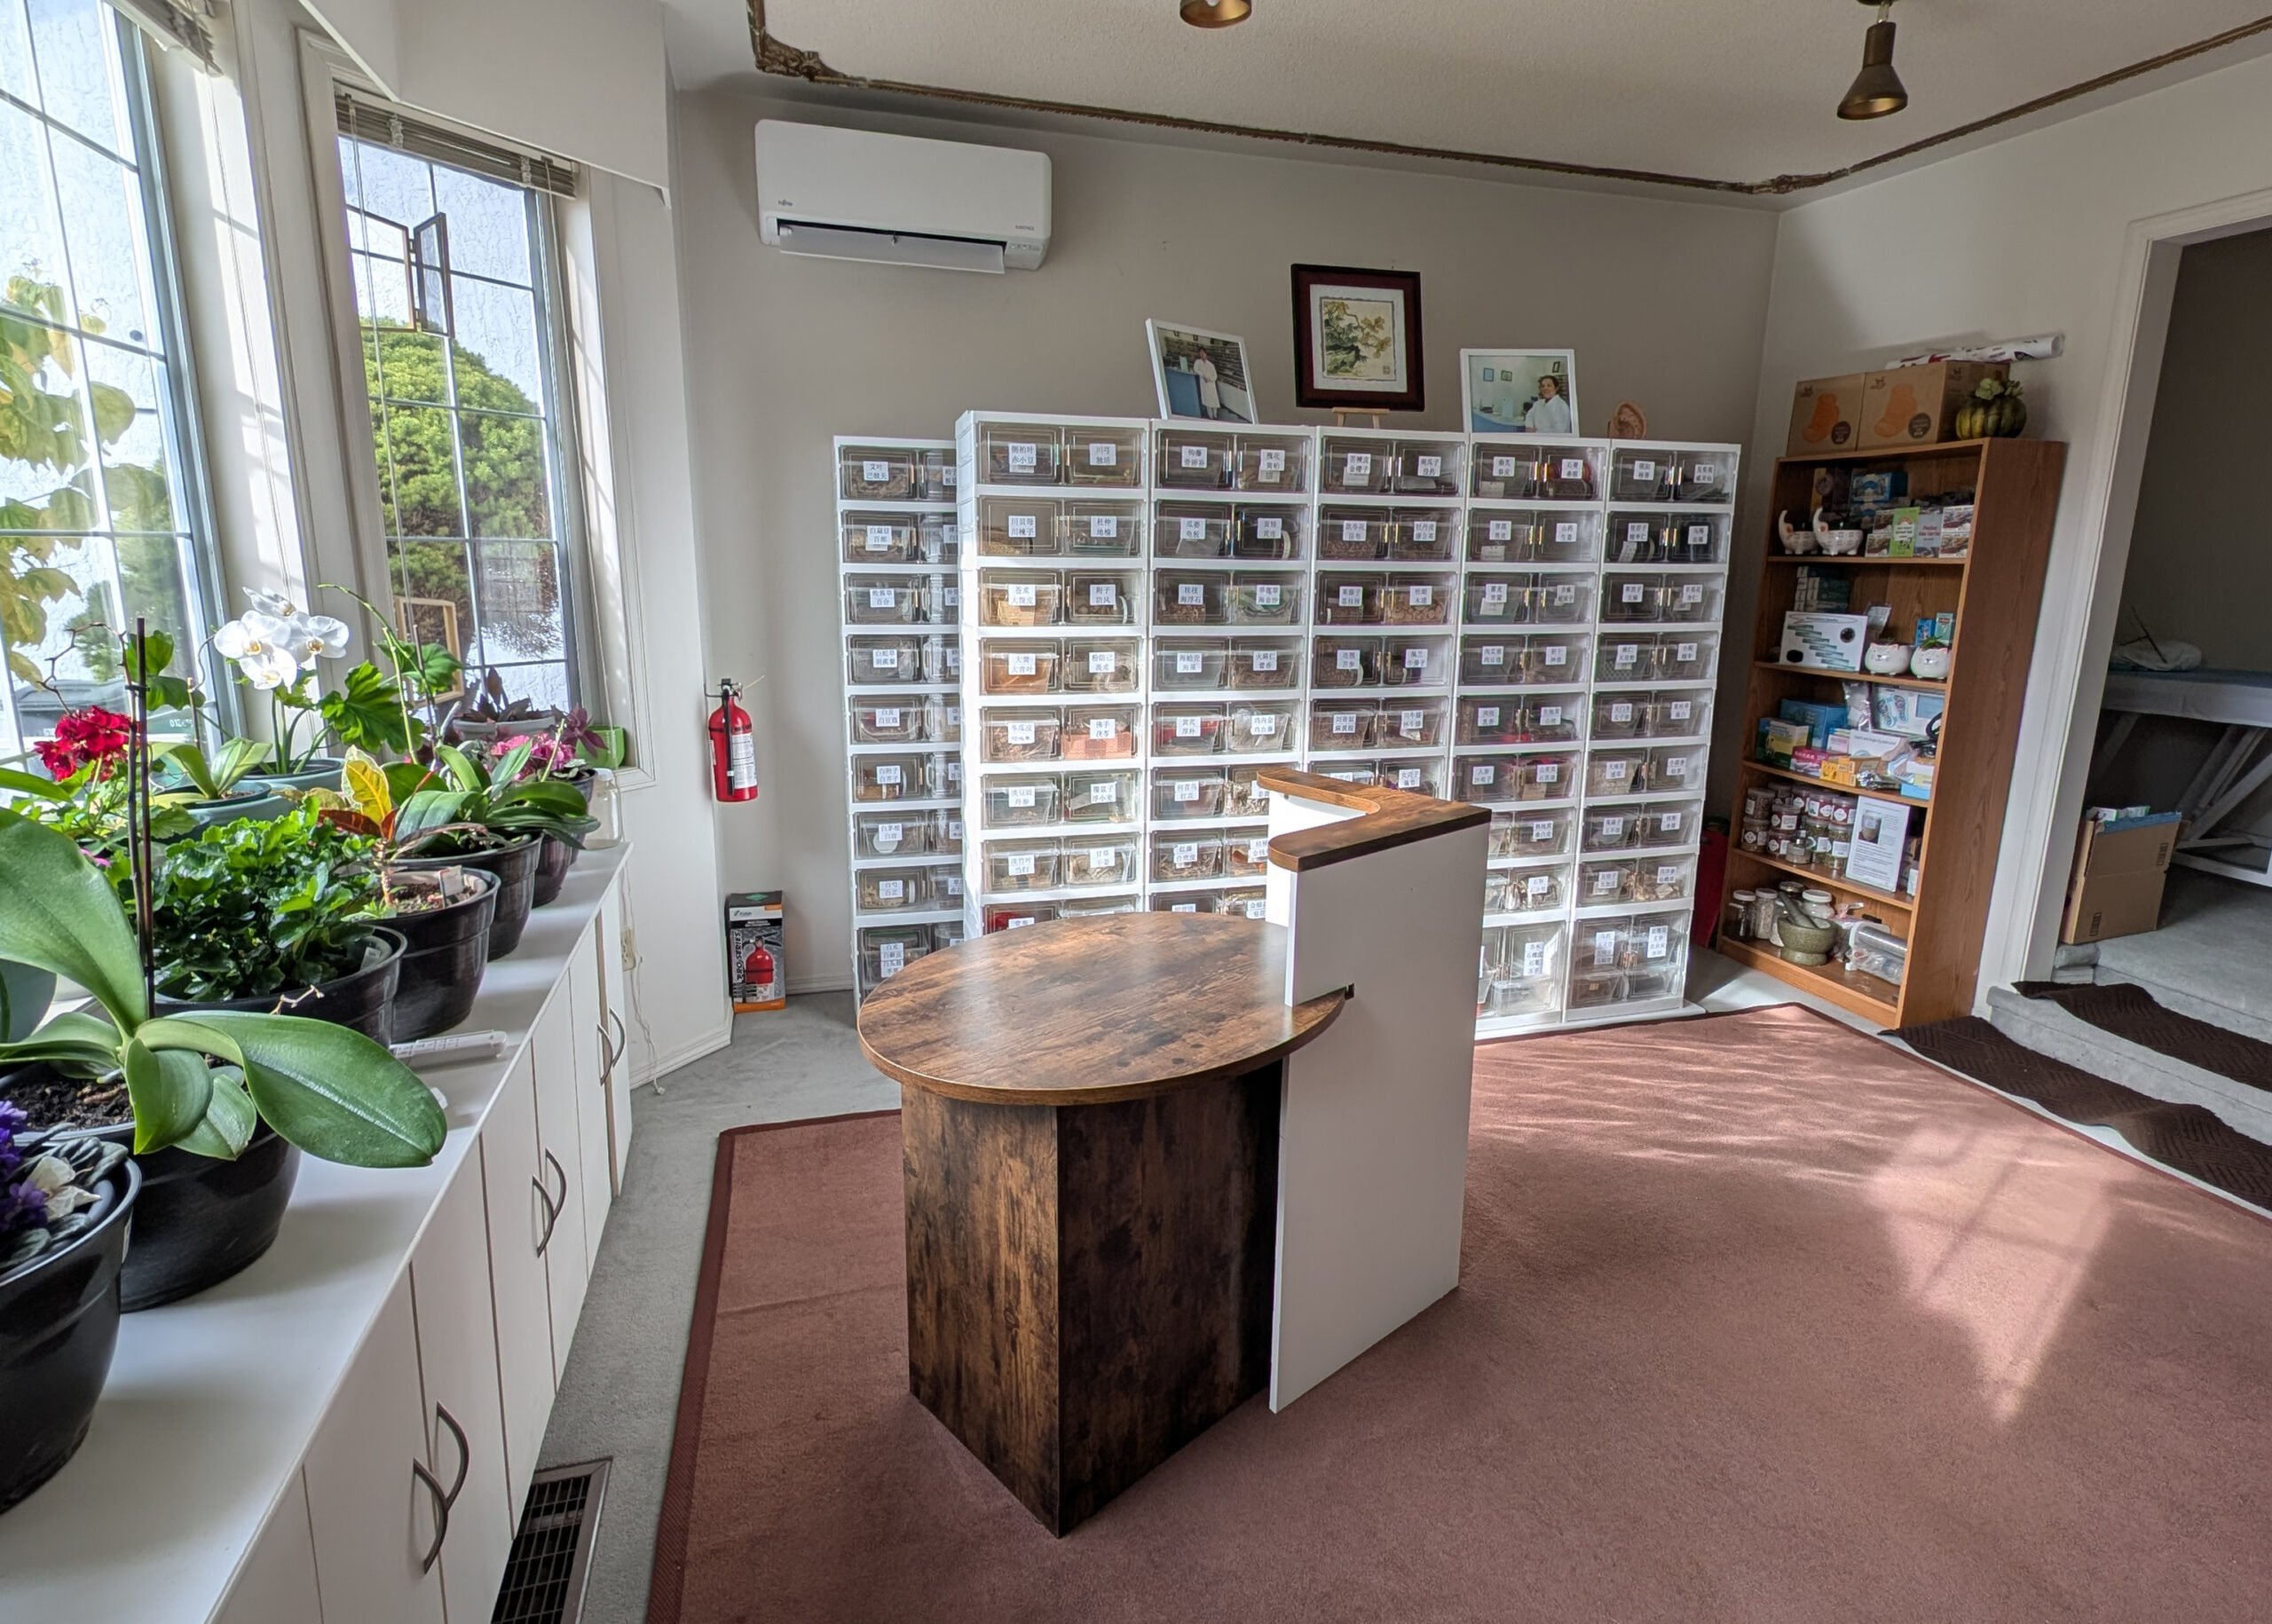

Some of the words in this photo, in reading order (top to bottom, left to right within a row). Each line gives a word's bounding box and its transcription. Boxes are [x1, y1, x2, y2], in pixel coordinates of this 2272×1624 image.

[1096, 446, 1110, 455] 川芎
[1011, 455, 1034, 464] 赤小豆
[1350, 455, 1369, 464] 苦楝皮
[1011, 517, 1034, 526] 川贝母
[1097, 517, 1111, 526] 杜仲
[1401, 771, 1418, 780] 女贞子
